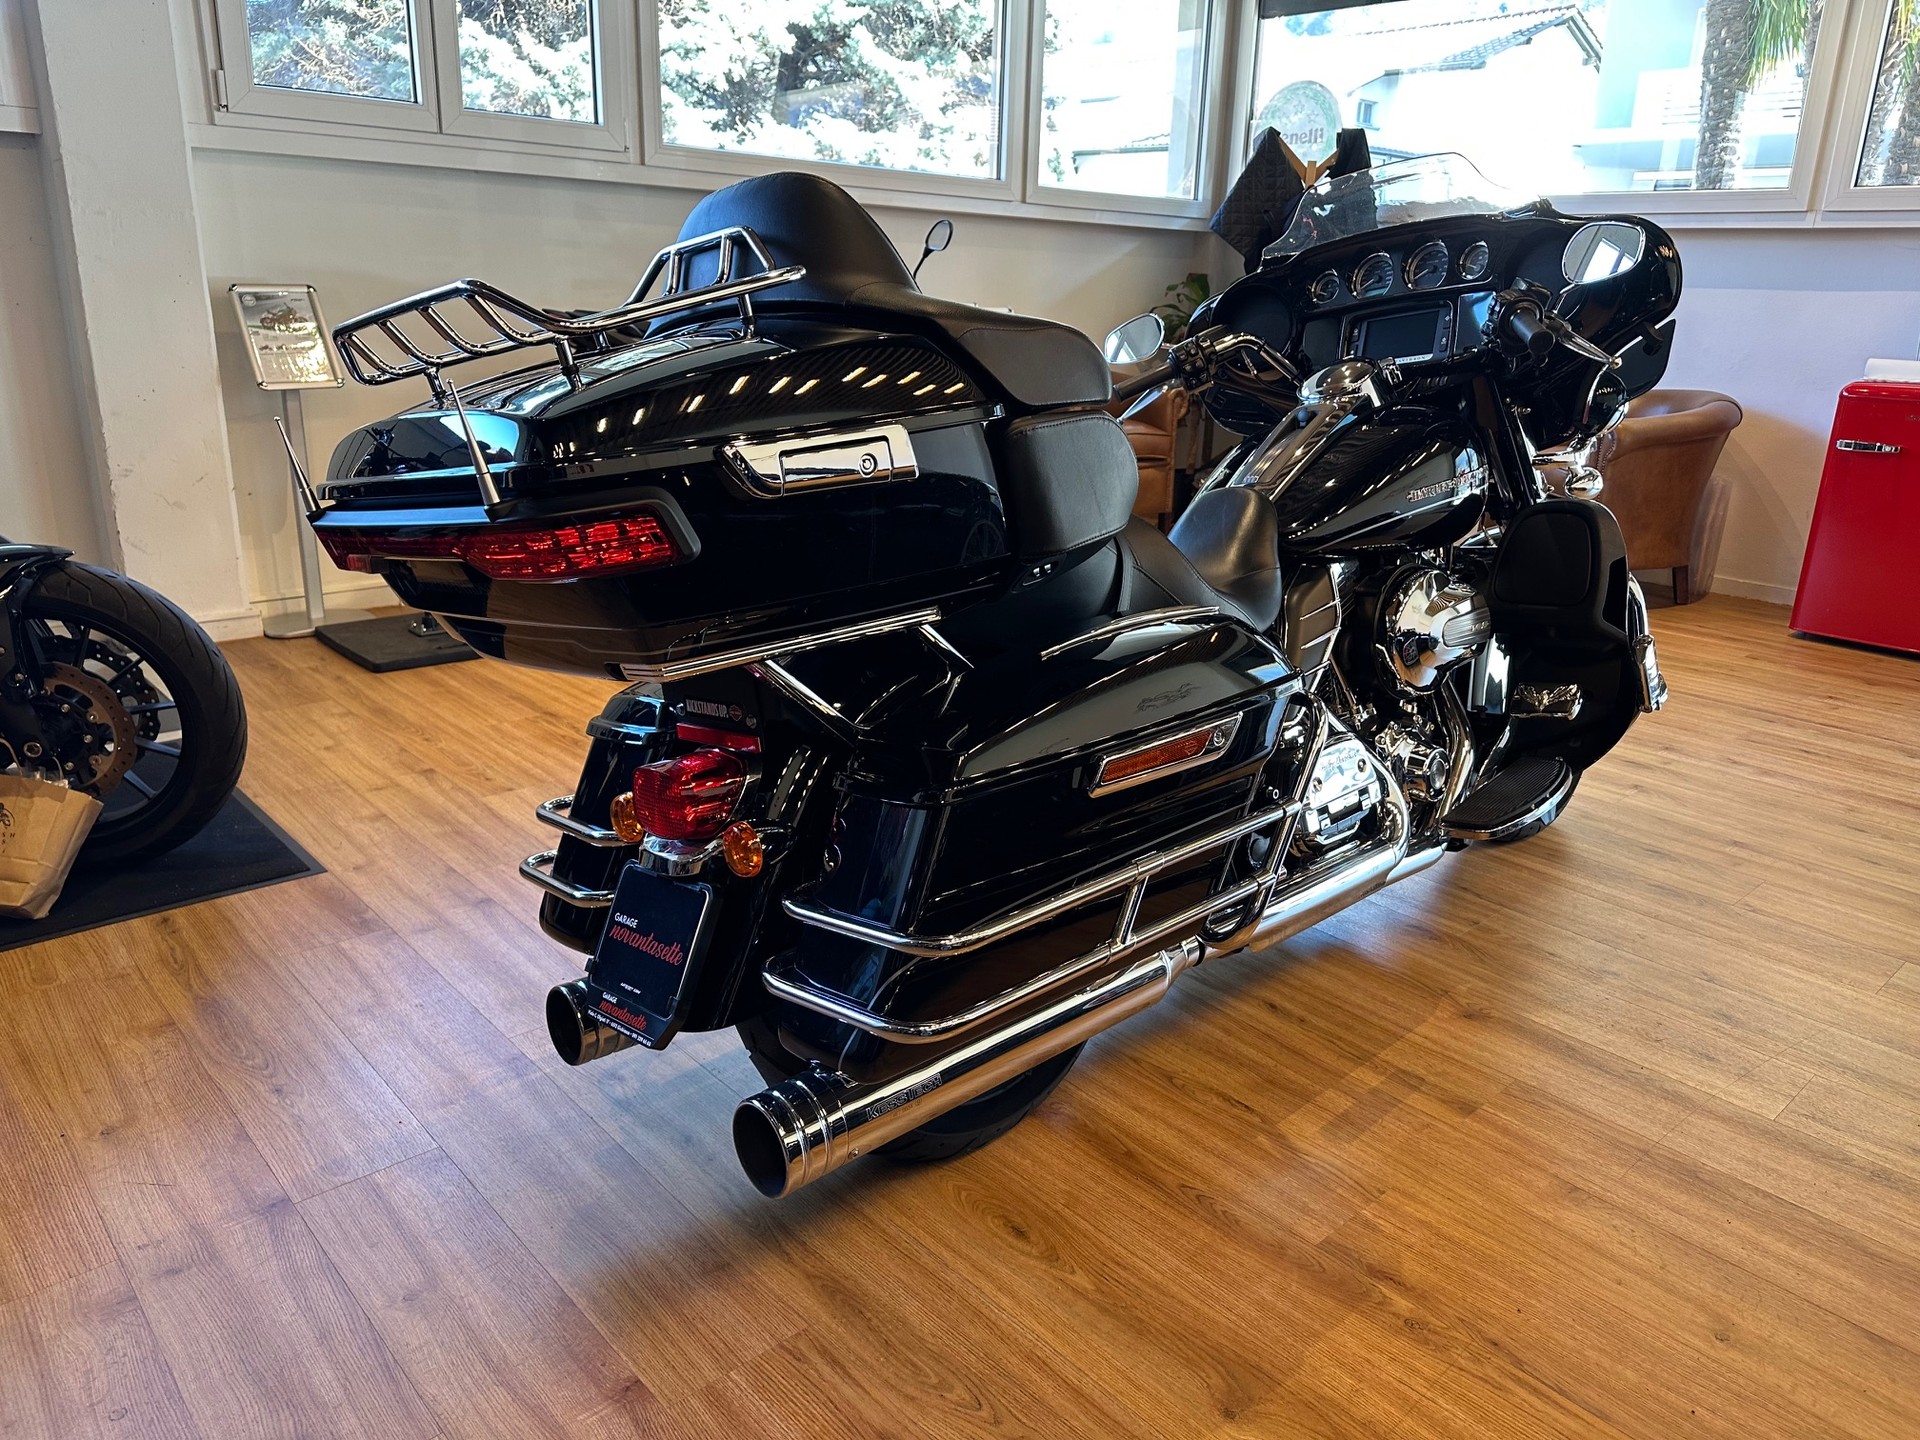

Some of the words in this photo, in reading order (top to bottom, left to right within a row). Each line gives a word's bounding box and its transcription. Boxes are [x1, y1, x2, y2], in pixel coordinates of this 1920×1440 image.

[1282, 127, 1324, 144] enelli
[685, 699, 718, 717] KICKSTANDS
[614, 912, 638, 928] GARAGE
[609, 924, 683, 966] novantasette
[599, 1000, 647, 1031] novantasette
